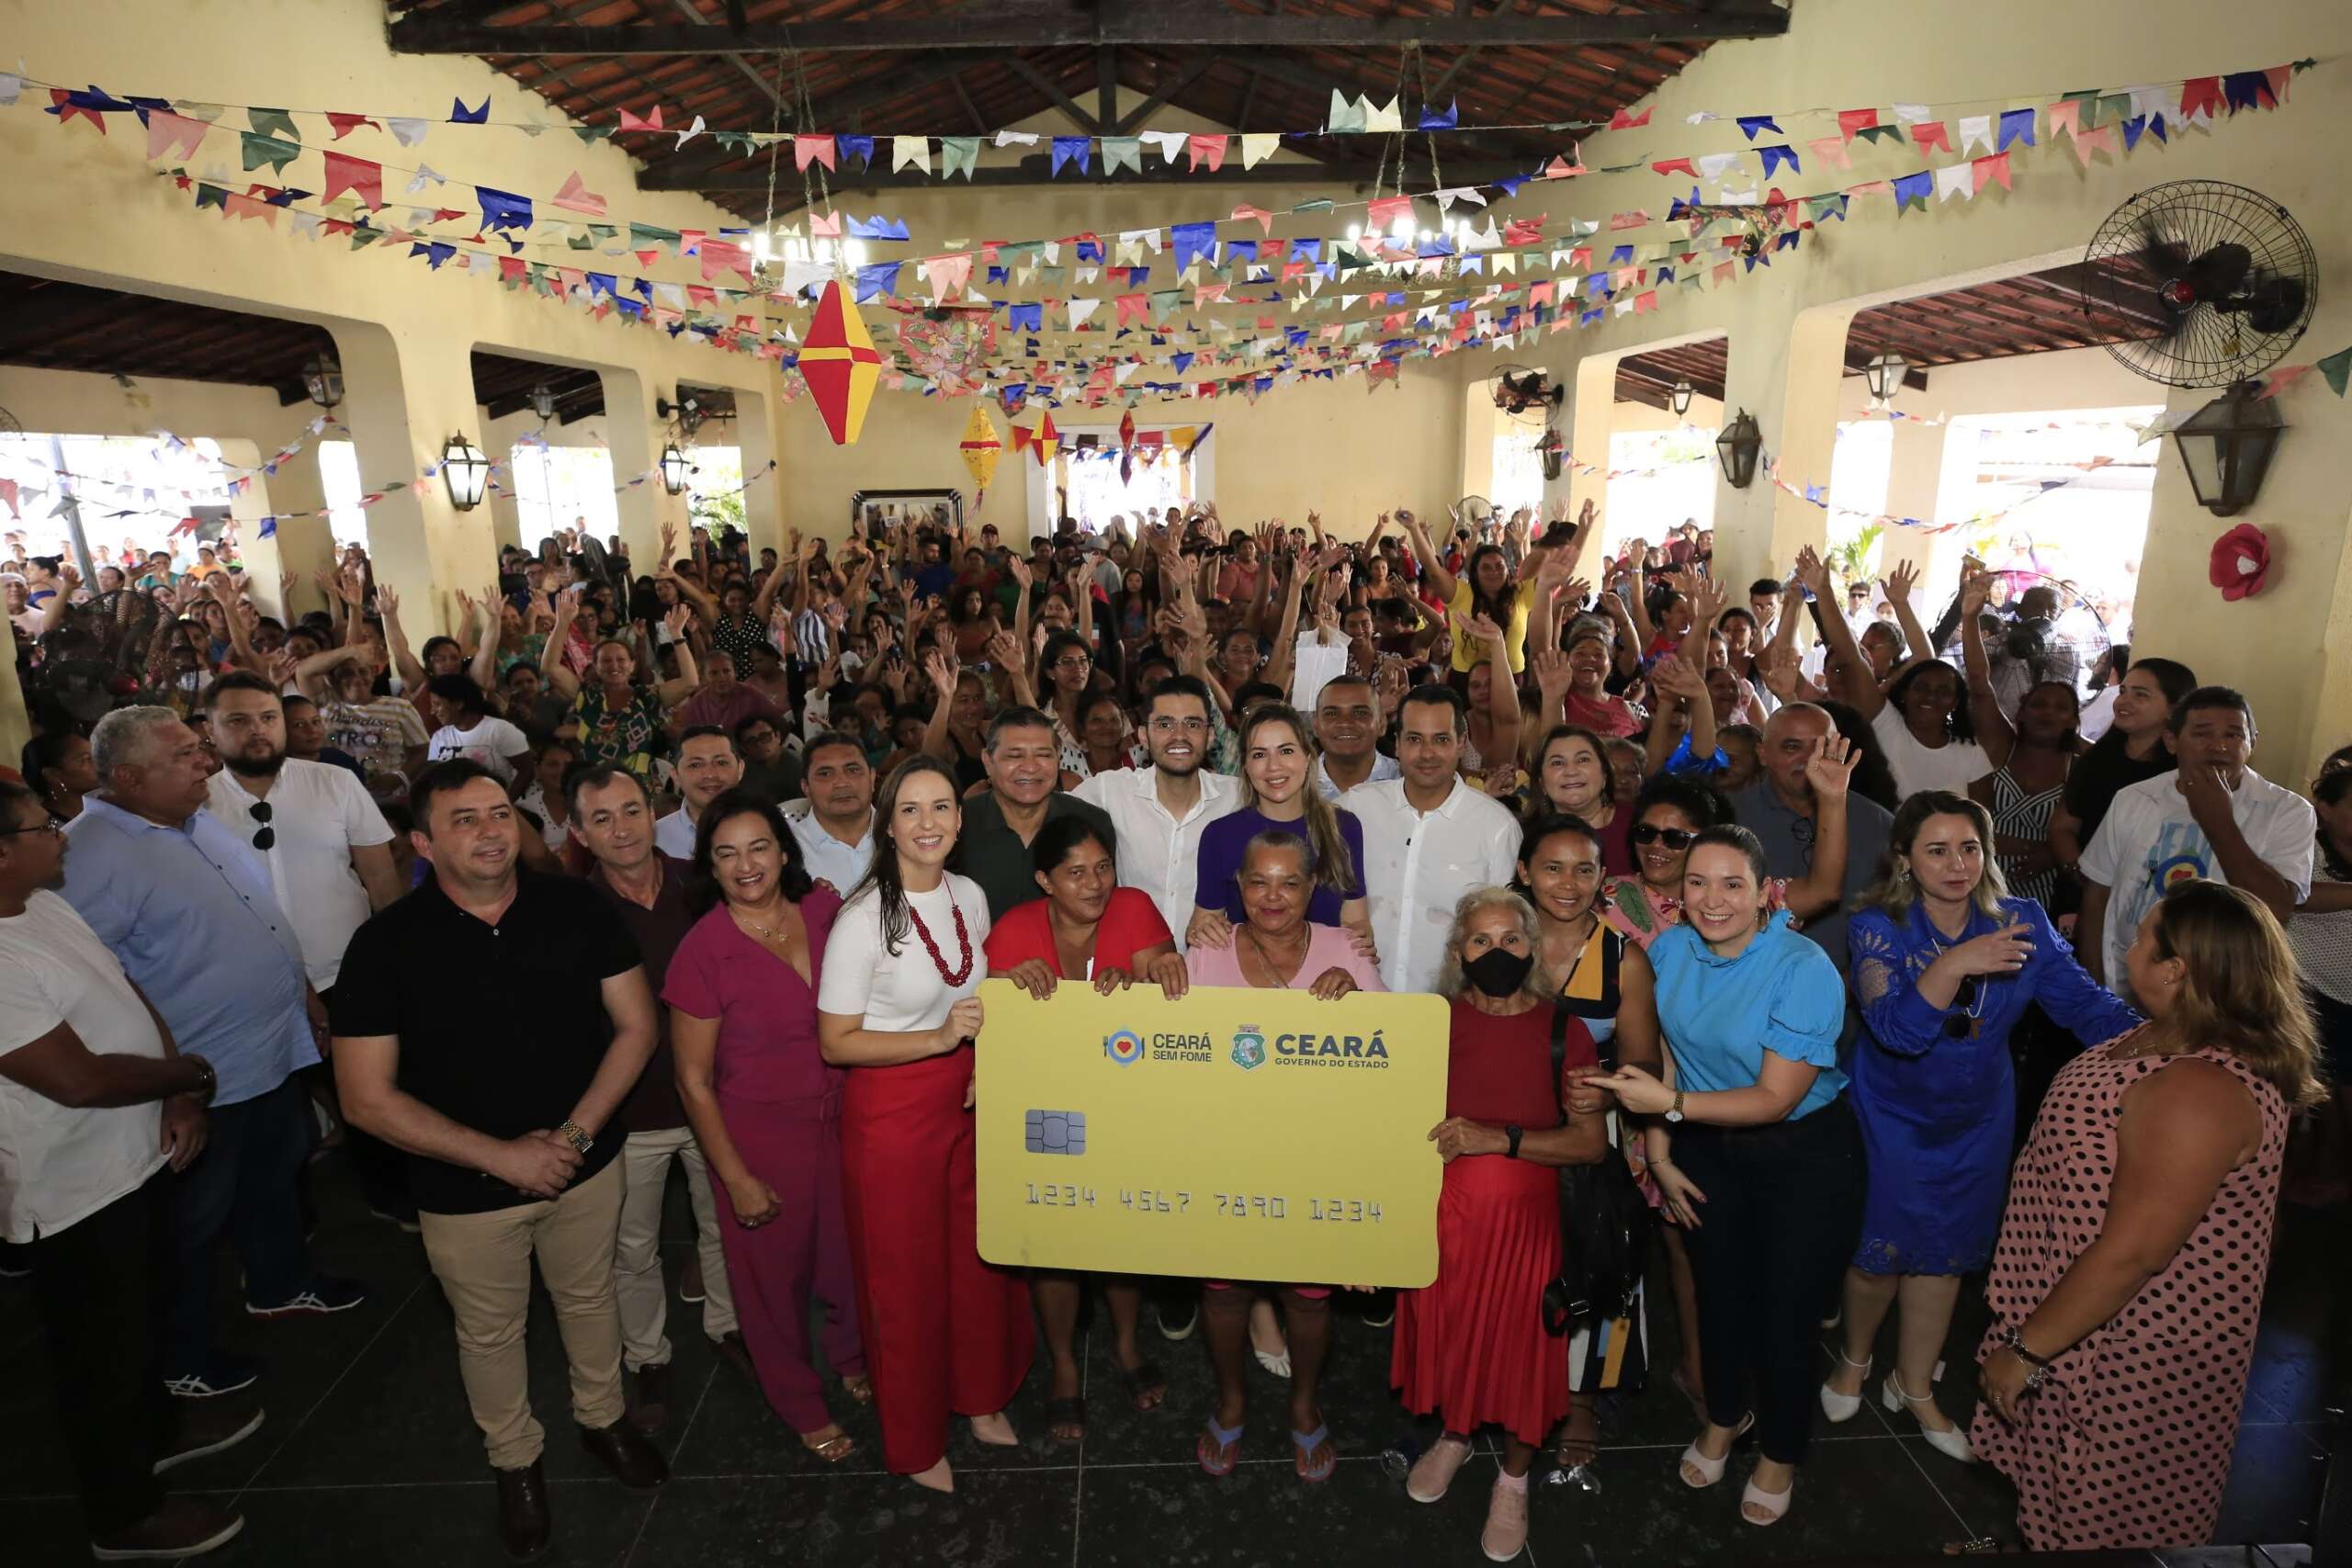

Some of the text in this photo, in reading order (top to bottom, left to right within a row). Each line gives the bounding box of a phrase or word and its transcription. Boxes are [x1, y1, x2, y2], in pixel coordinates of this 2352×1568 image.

[1152, 1032, 1212, 1050] CEARÁ
[1274, 1029, 1389, 1059] CEARÁ
[1152, 1050, 1212, 1063] SEM FOME
[1274, 1057, 1389, 1069] GOVERNO DO ESTADO
[1026, 1182, 1382, 1223] 1234 4567 7890 1234
